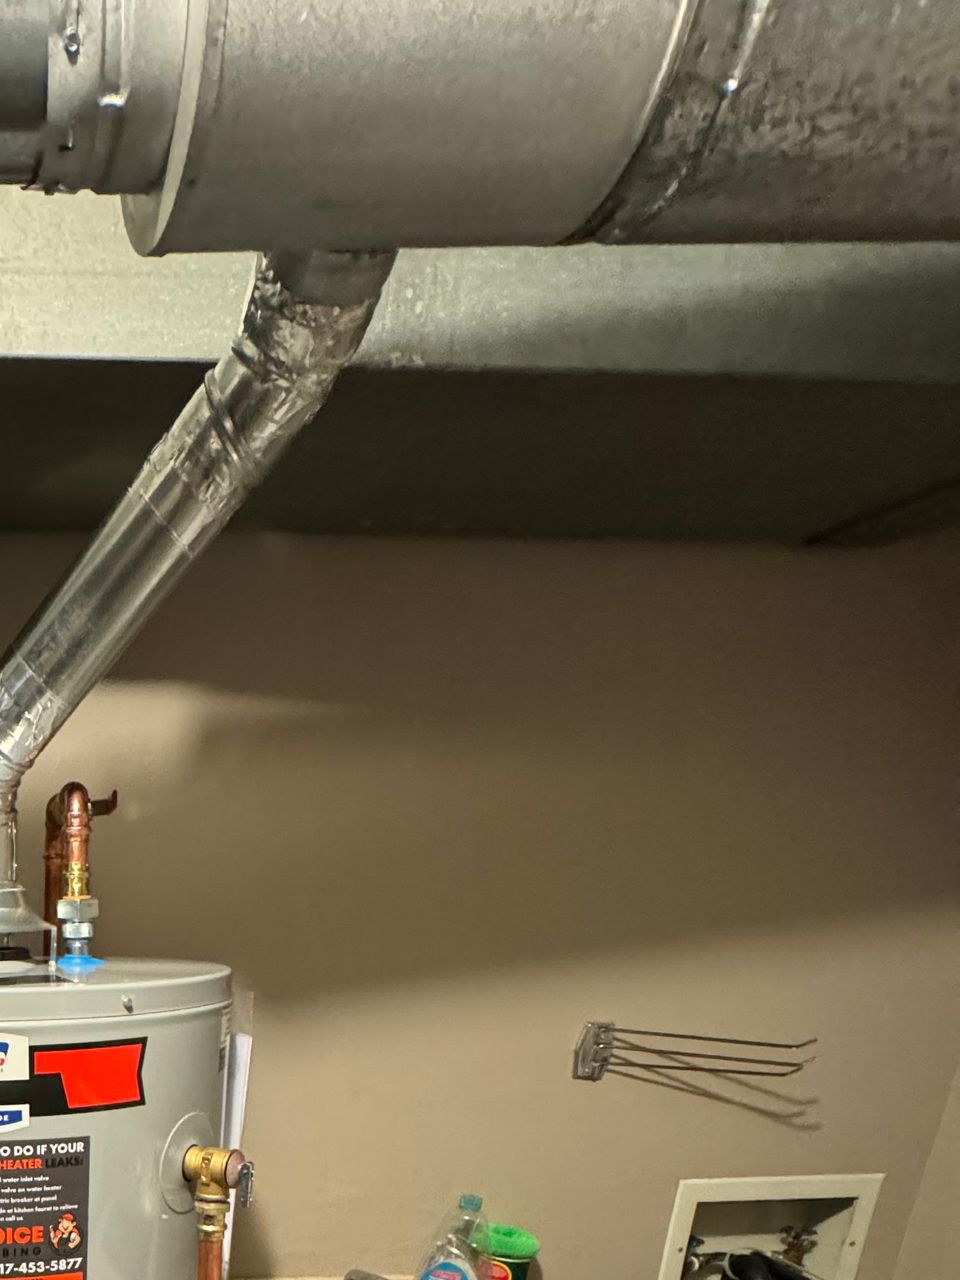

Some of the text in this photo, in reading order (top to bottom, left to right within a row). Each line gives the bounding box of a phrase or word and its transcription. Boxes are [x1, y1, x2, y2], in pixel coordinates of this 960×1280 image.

[14, 1145, 34, 1156] DO
[36, 1144, 48, 1155] IF
[49, 1142, 85, 1154] YOUR
